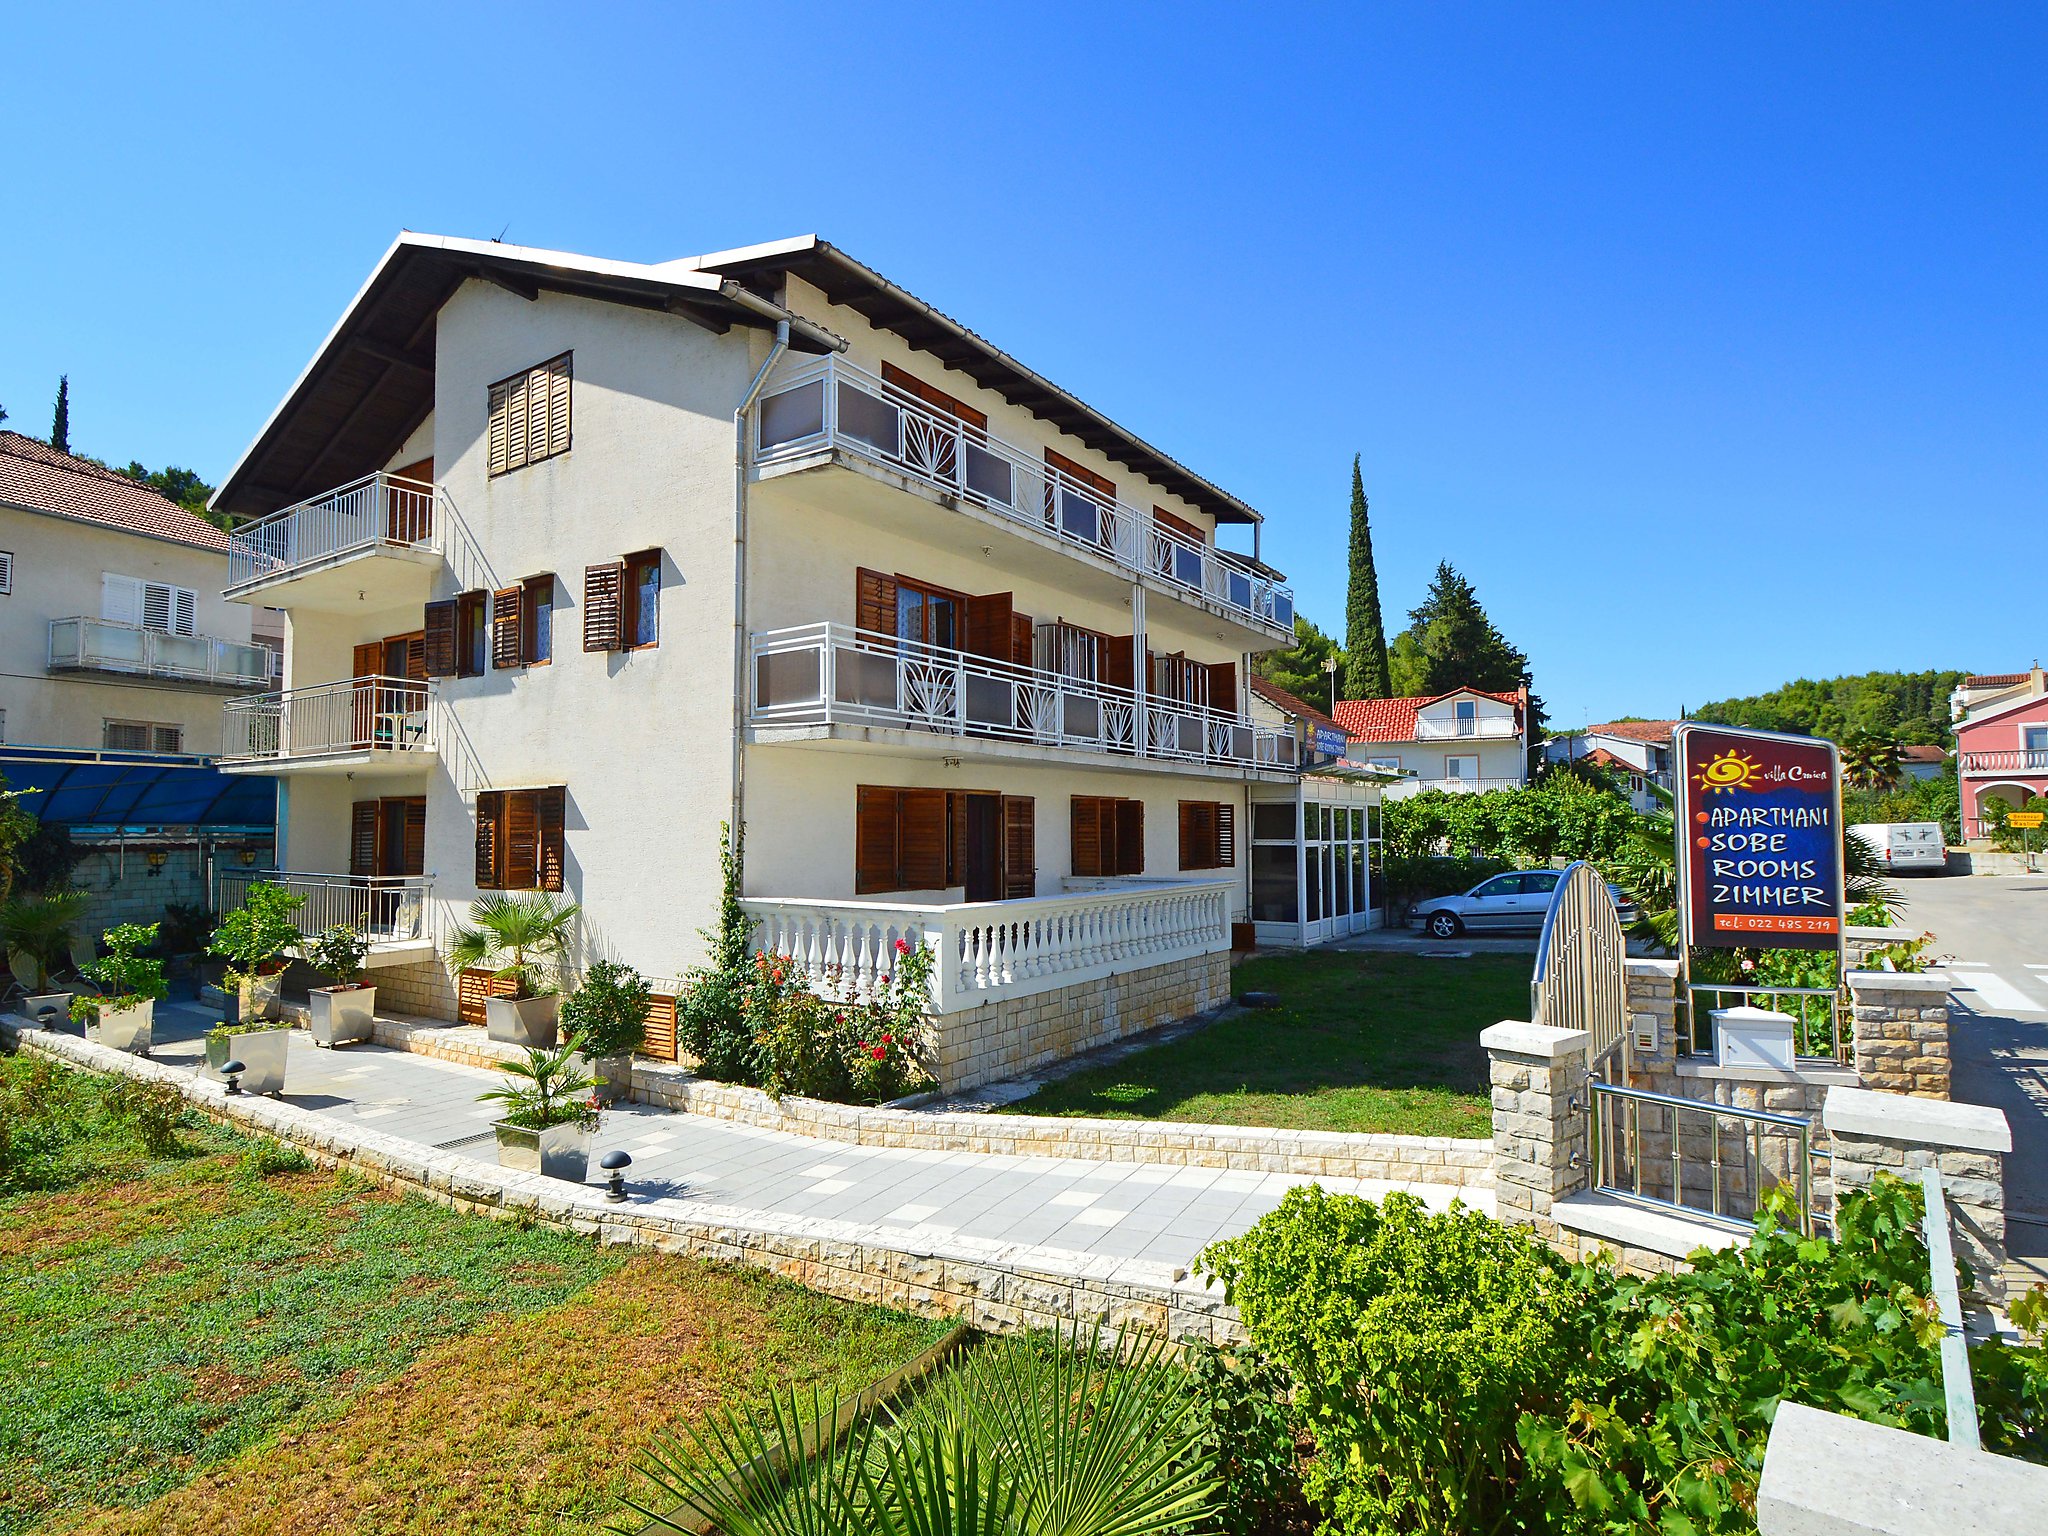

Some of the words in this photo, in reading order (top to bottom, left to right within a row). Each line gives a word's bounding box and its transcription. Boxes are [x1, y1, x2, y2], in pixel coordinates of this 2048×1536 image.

[1763, 765, 1786, 782] villa
[1711, 807, 1829, 828] APARTMANI
[1711, 833, 1788, 852] SOBE
[1713, 859, 1816, 880] ROOMS
[1713, 884, 1831, 907] ZIMMER
[1719, 917, 1743, 929] tel:
[1748, 919, 1772, 928] 022
[1778, 920, 1802, 929] 485
[1807, 920, 1830, 930] 219
